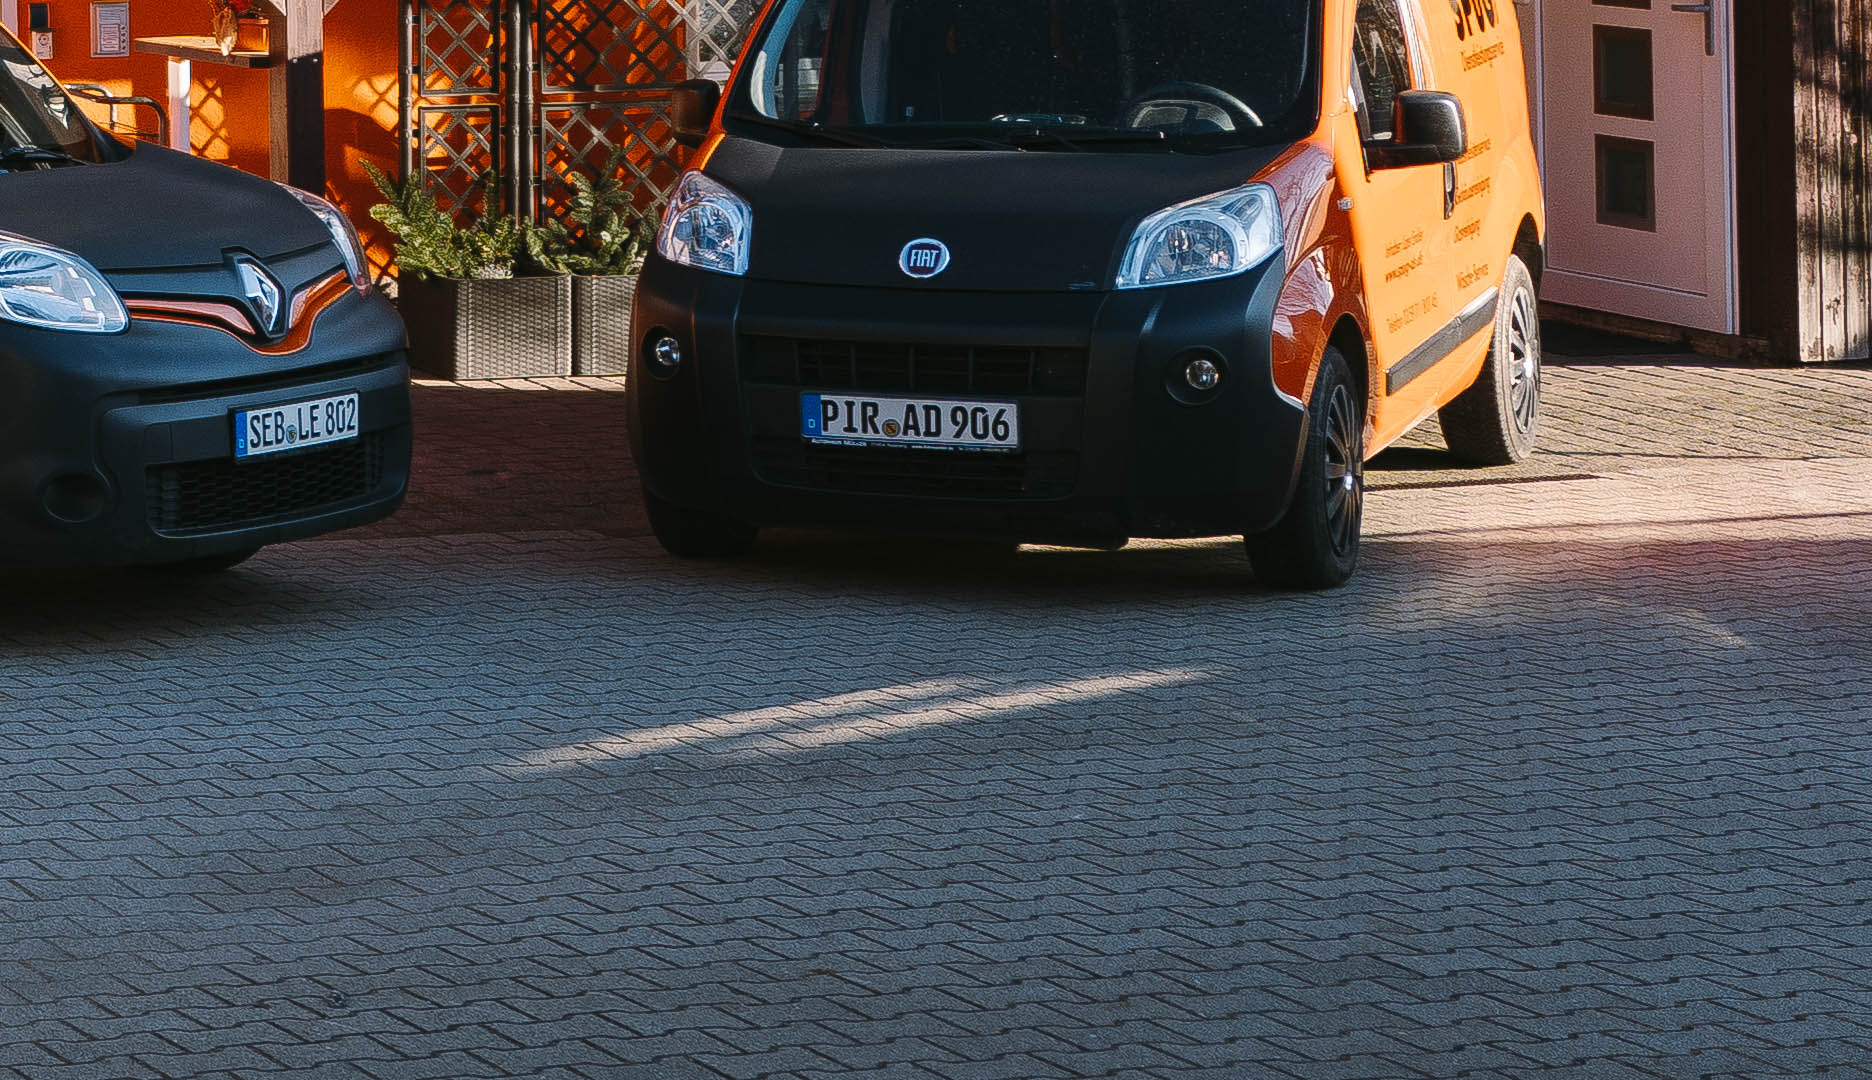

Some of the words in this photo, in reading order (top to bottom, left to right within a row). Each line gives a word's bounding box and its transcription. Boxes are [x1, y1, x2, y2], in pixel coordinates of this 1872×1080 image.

[909, 249, 940, 268] FIAT
[249, 410, 285, 449] SEB
[297, 403, 321, 441] LE
[325, 397, 356, 436] 802
[820, 398, 881, 435] PIR
[902, 403, 943, 438] AD
[950, 405, 1010, 441] 906
